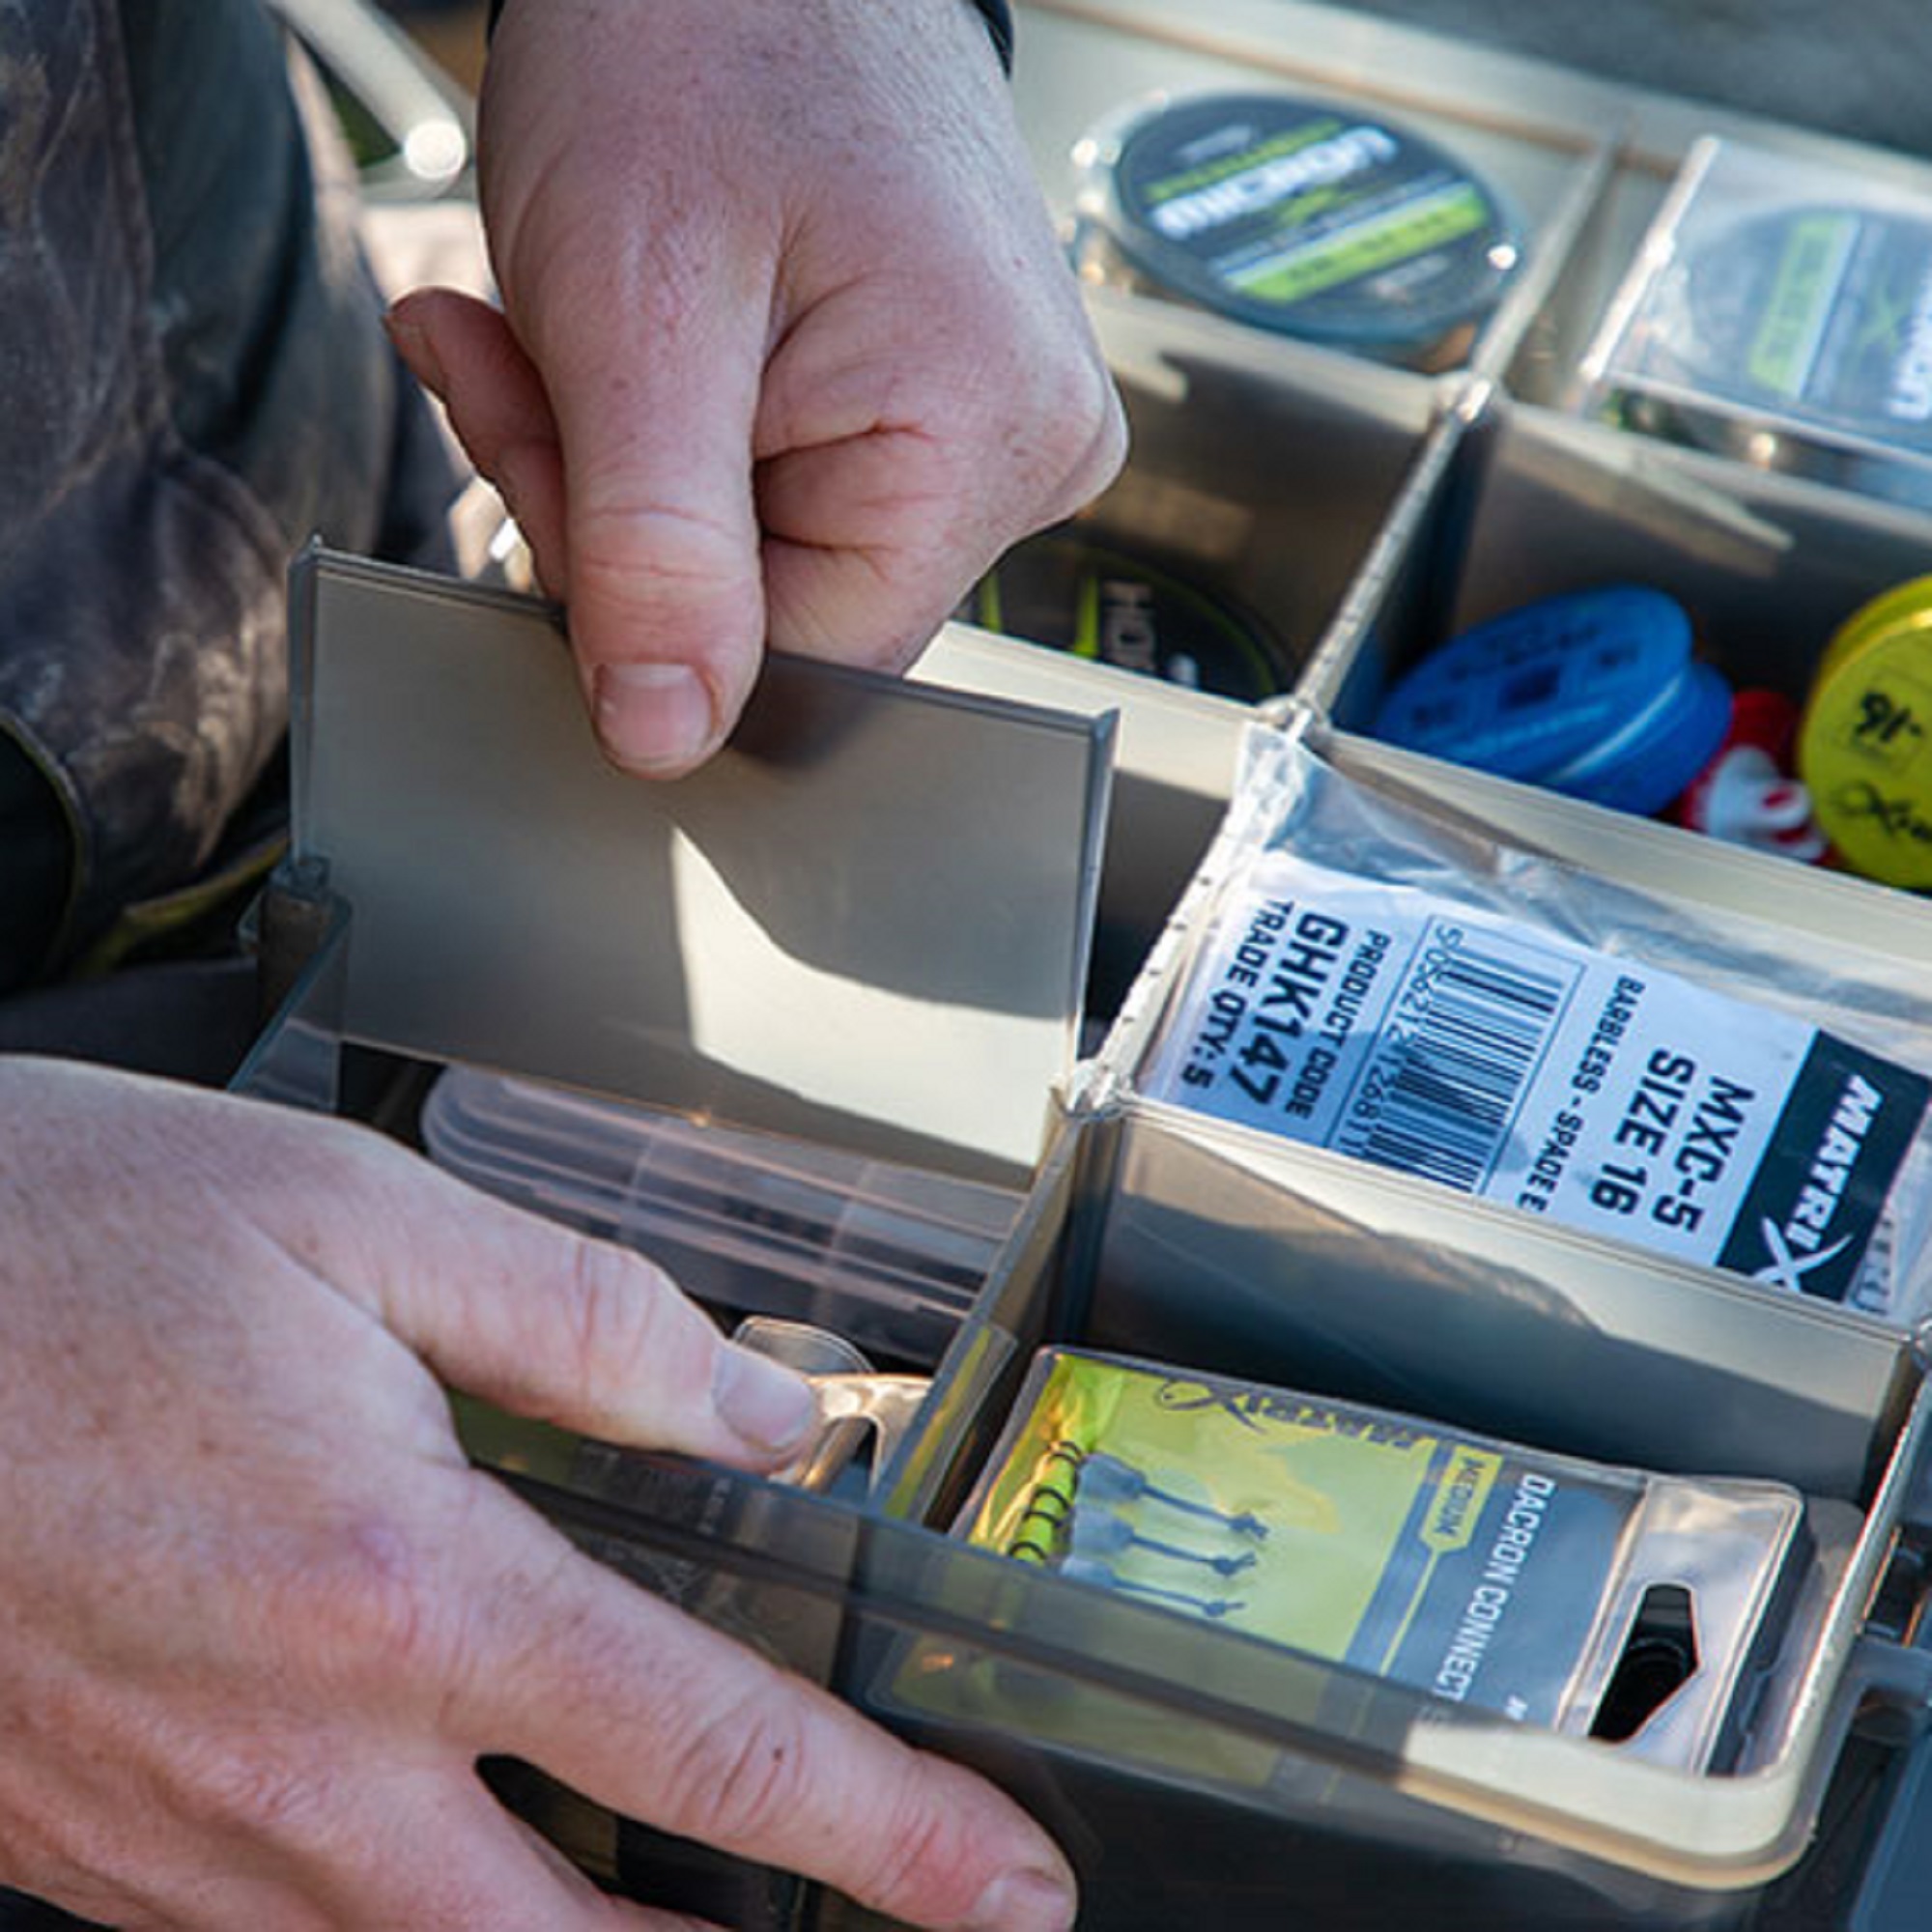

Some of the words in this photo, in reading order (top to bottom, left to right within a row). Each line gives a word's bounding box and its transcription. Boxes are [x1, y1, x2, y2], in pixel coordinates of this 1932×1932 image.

[1226, 898, 1294, 988] TRADE
[1320, 928, 1392, 1048] PRODUCT
[1194, 988, 1247, 1062] QTY:
[1228, 911, 1350, 1105] GHK147
[1572, 976, 1645, 1094] BARBLESS
[1284, 1046, 1340, 1121] CODE
[1614, 1048, 1696, 1155] SIZE
[1527, 1110, 1584, 1194] SPADE
[1588, 1162, 1647, 1216] 16
[1651, 1075, 1756, 1233] MXC-5
[1750, 1073, 1885, 1293] MATRIX
[1489, 1473, 1555, 1591] DACRON
[1428, 1586, 1509, 1704] CONNECT
